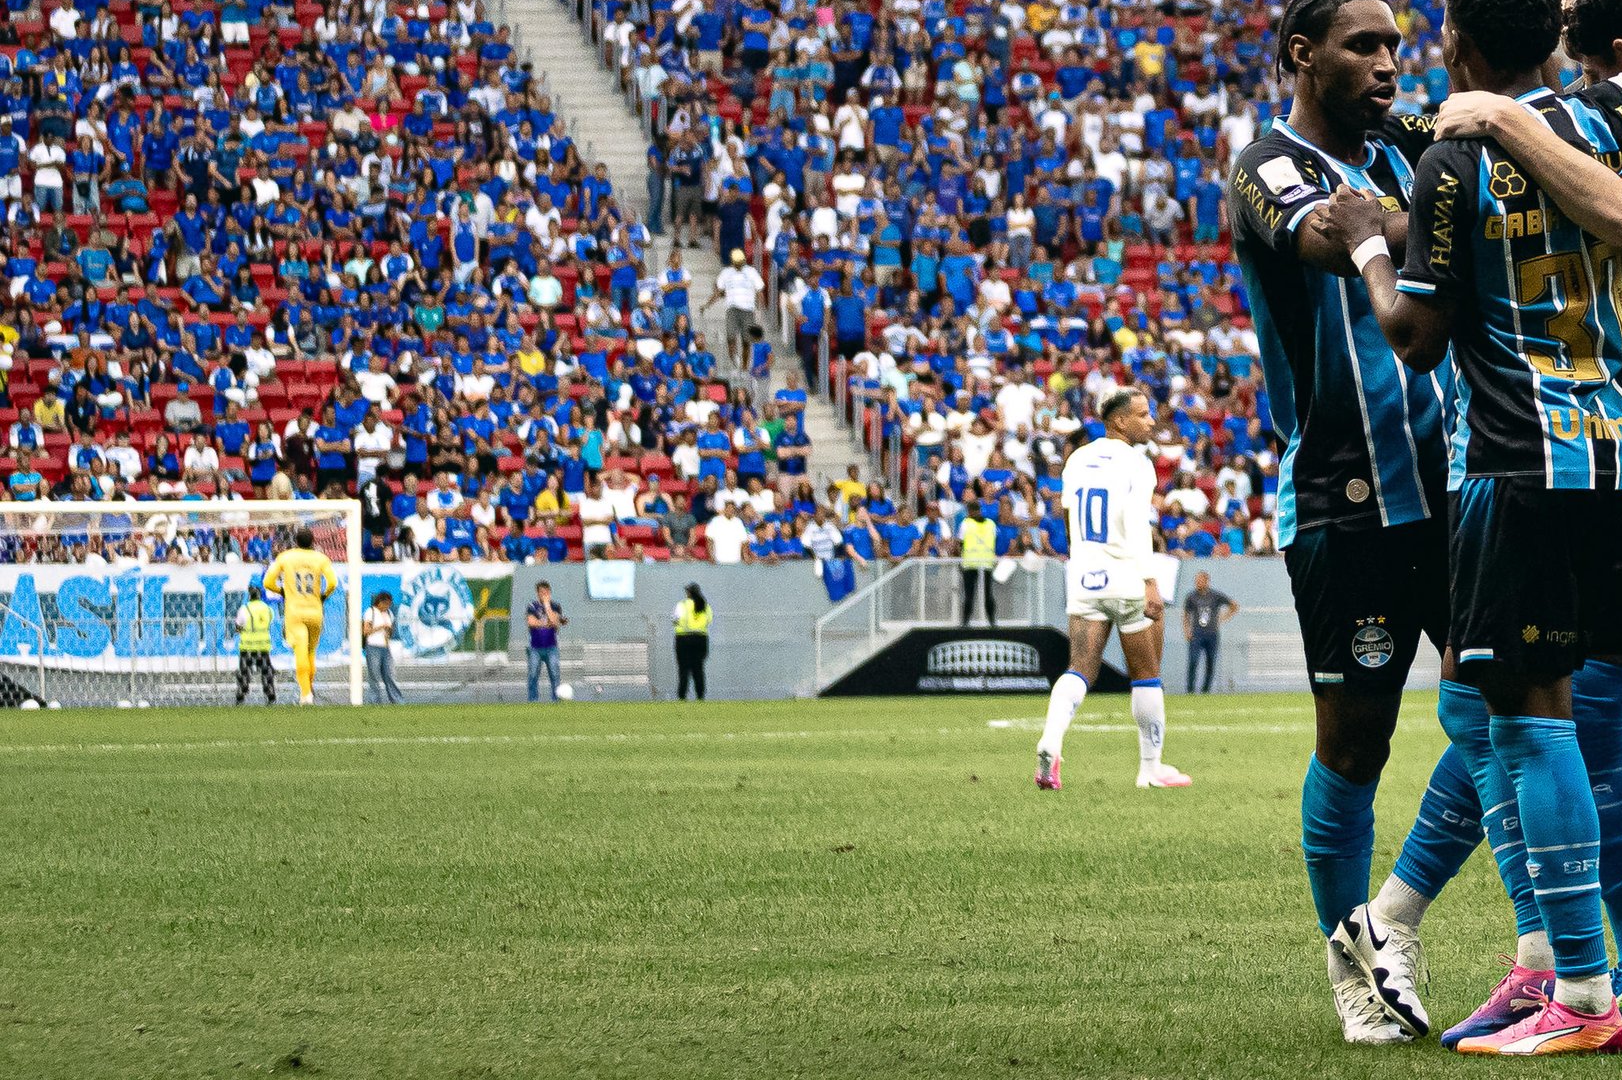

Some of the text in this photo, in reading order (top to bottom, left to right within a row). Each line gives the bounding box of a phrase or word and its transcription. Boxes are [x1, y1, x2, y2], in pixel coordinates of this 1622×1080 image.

[1235, 166, 1284, 231] HAVAN
[1429, 171, 1460, 268] HAVAN
[1075, 487, 1109, 544] 10
